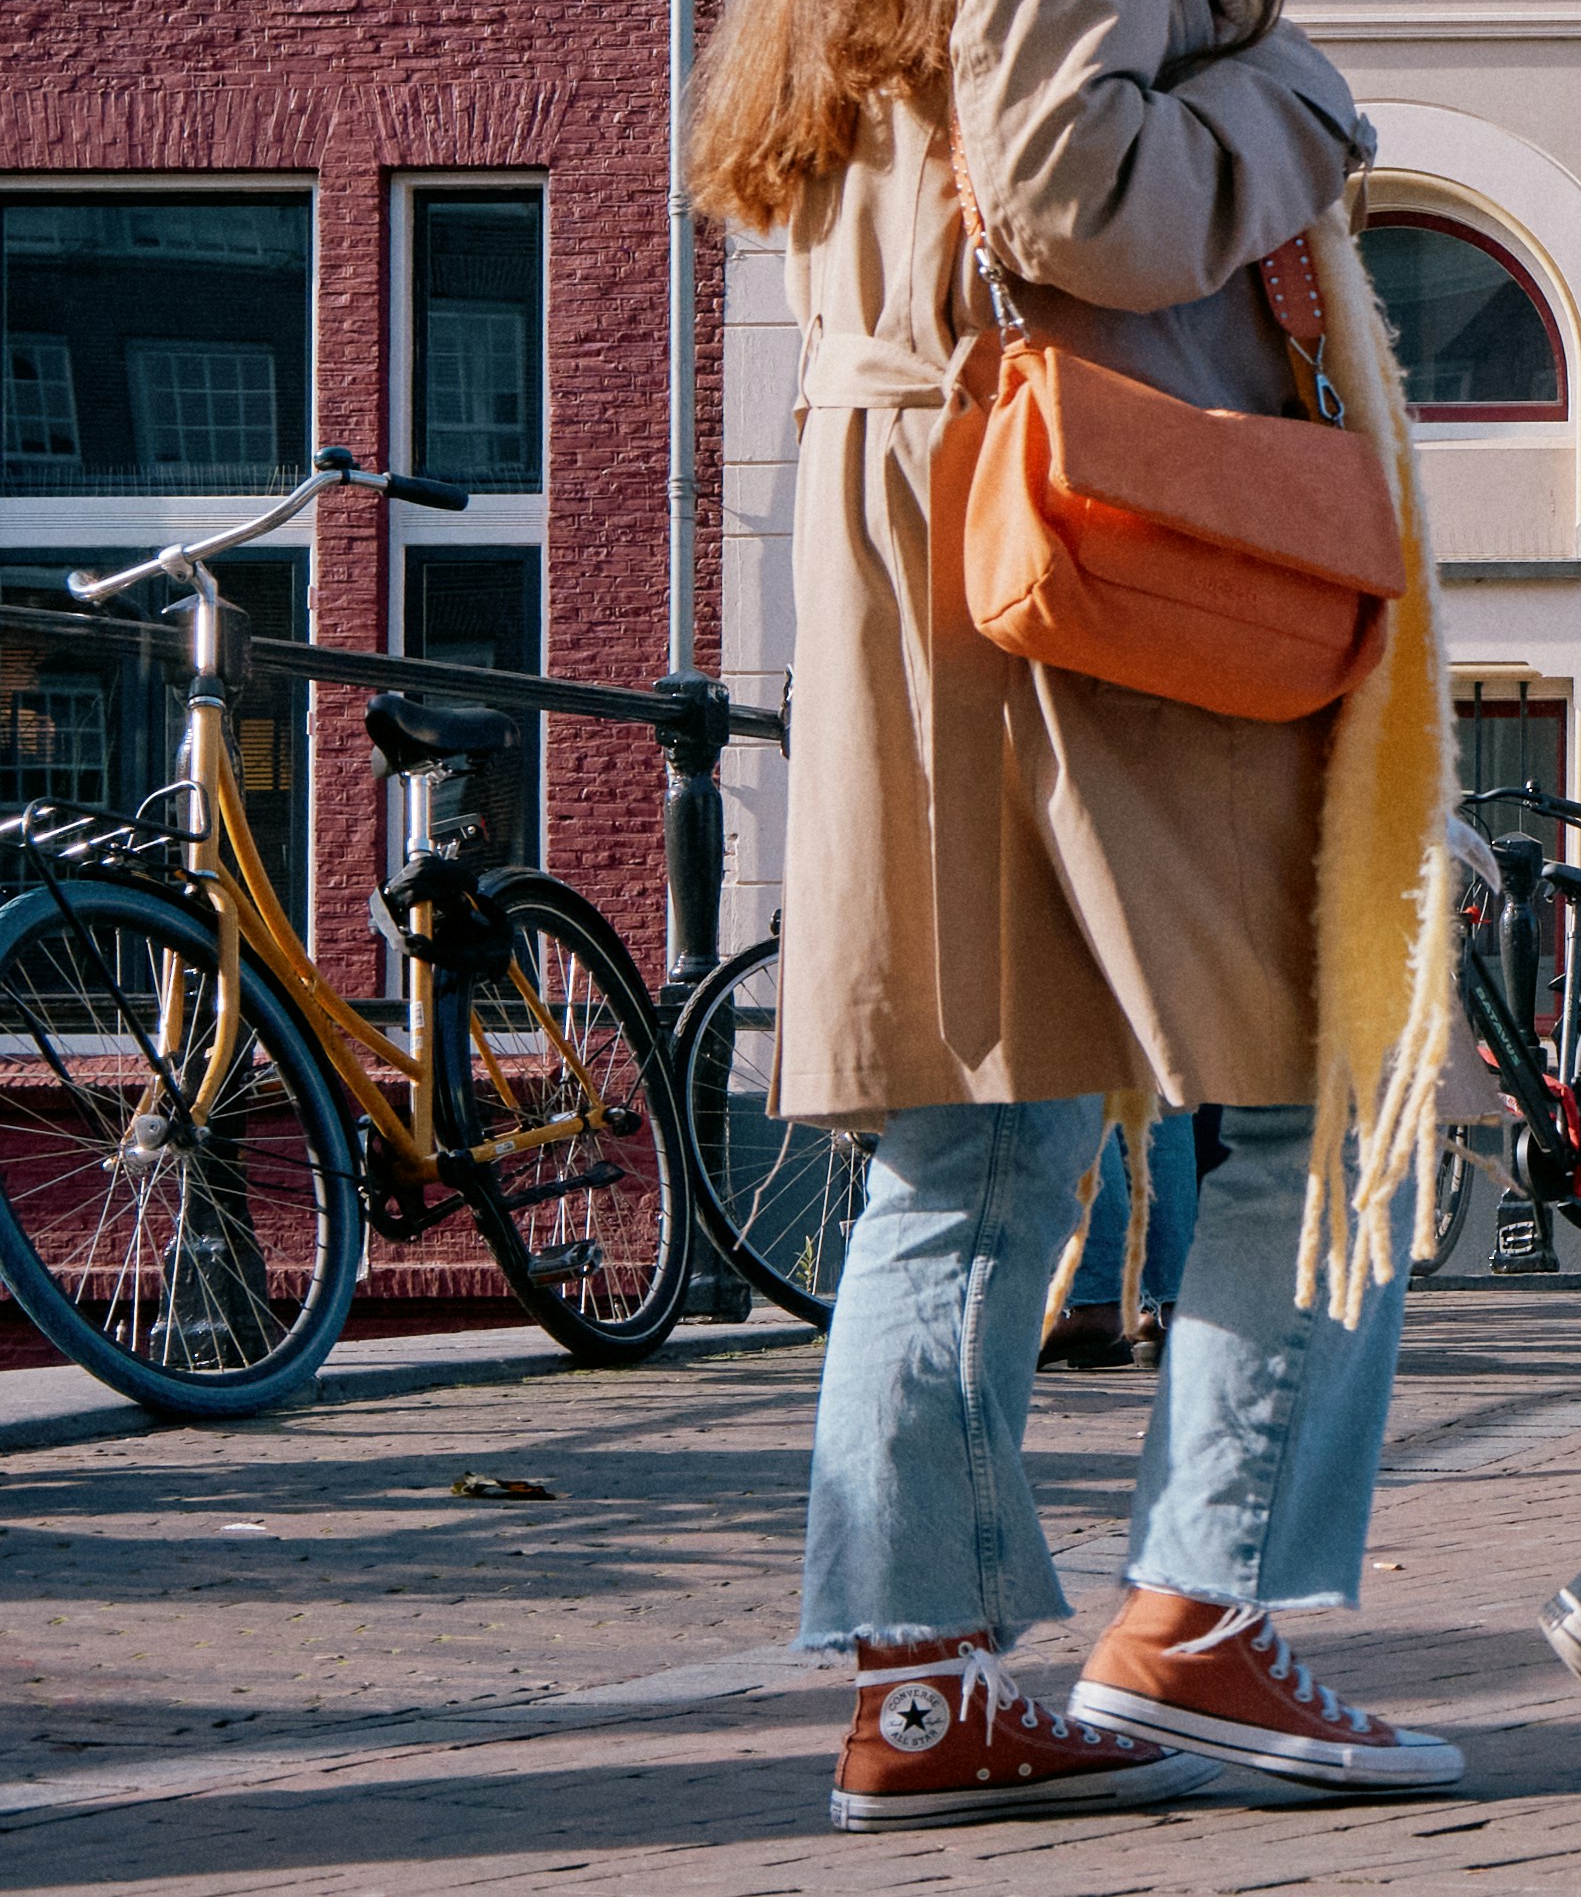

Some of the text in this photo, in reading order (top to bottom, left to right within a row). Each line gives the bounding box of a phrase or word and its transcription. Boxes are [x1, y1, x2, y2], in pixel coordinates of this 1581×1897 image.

[1475, 986, 1520, 1066] BATAVUS
[888, 1689, 941, 1712] CONVERSE
[891, 1729, 938, 1746] ALL STAR
